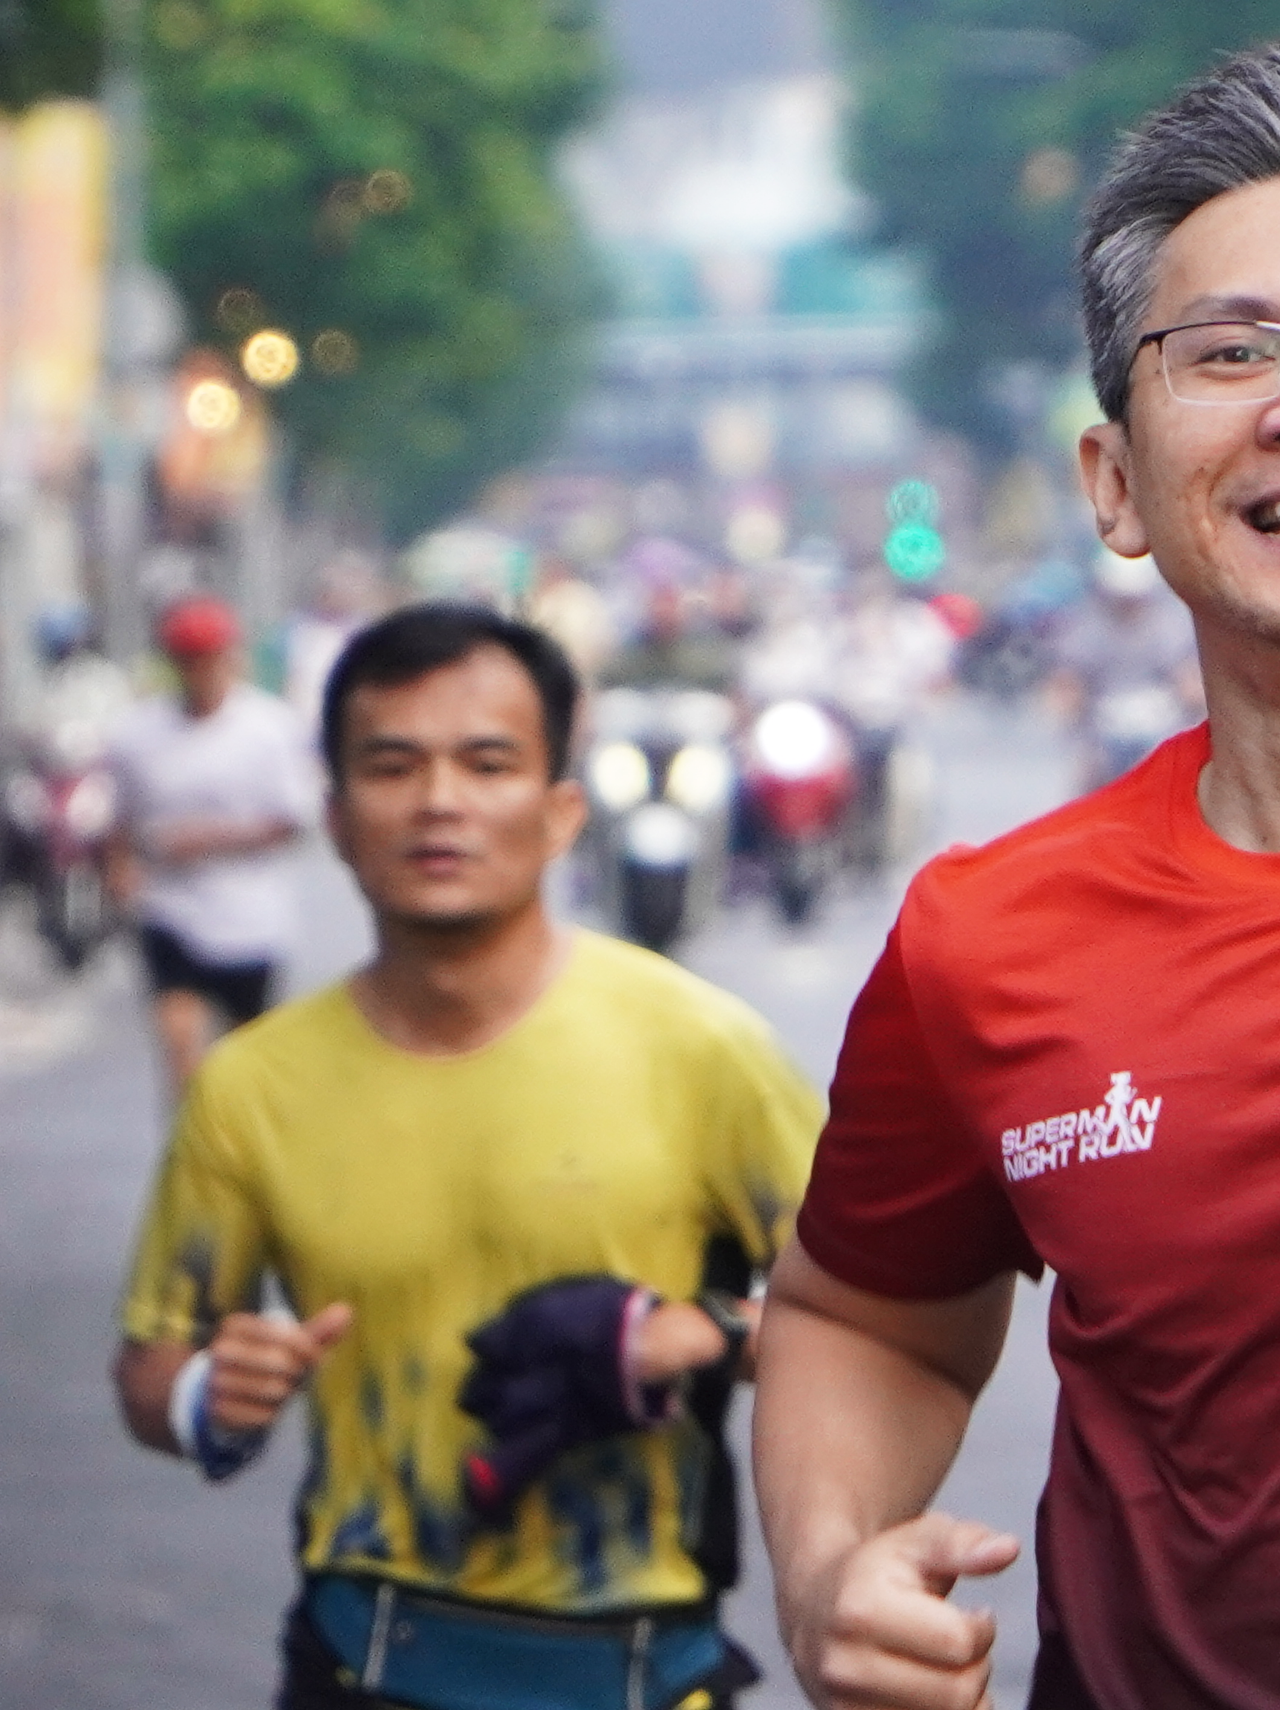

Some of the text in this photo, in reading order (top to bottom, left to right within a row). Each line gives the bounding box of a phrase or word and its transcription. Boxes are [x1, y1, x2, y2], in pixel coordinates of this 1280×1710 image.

[1002, 1088, 1162, 1156] SUPERMAN
[1003, 1122, 1155, 1182] NIGHT RUN
